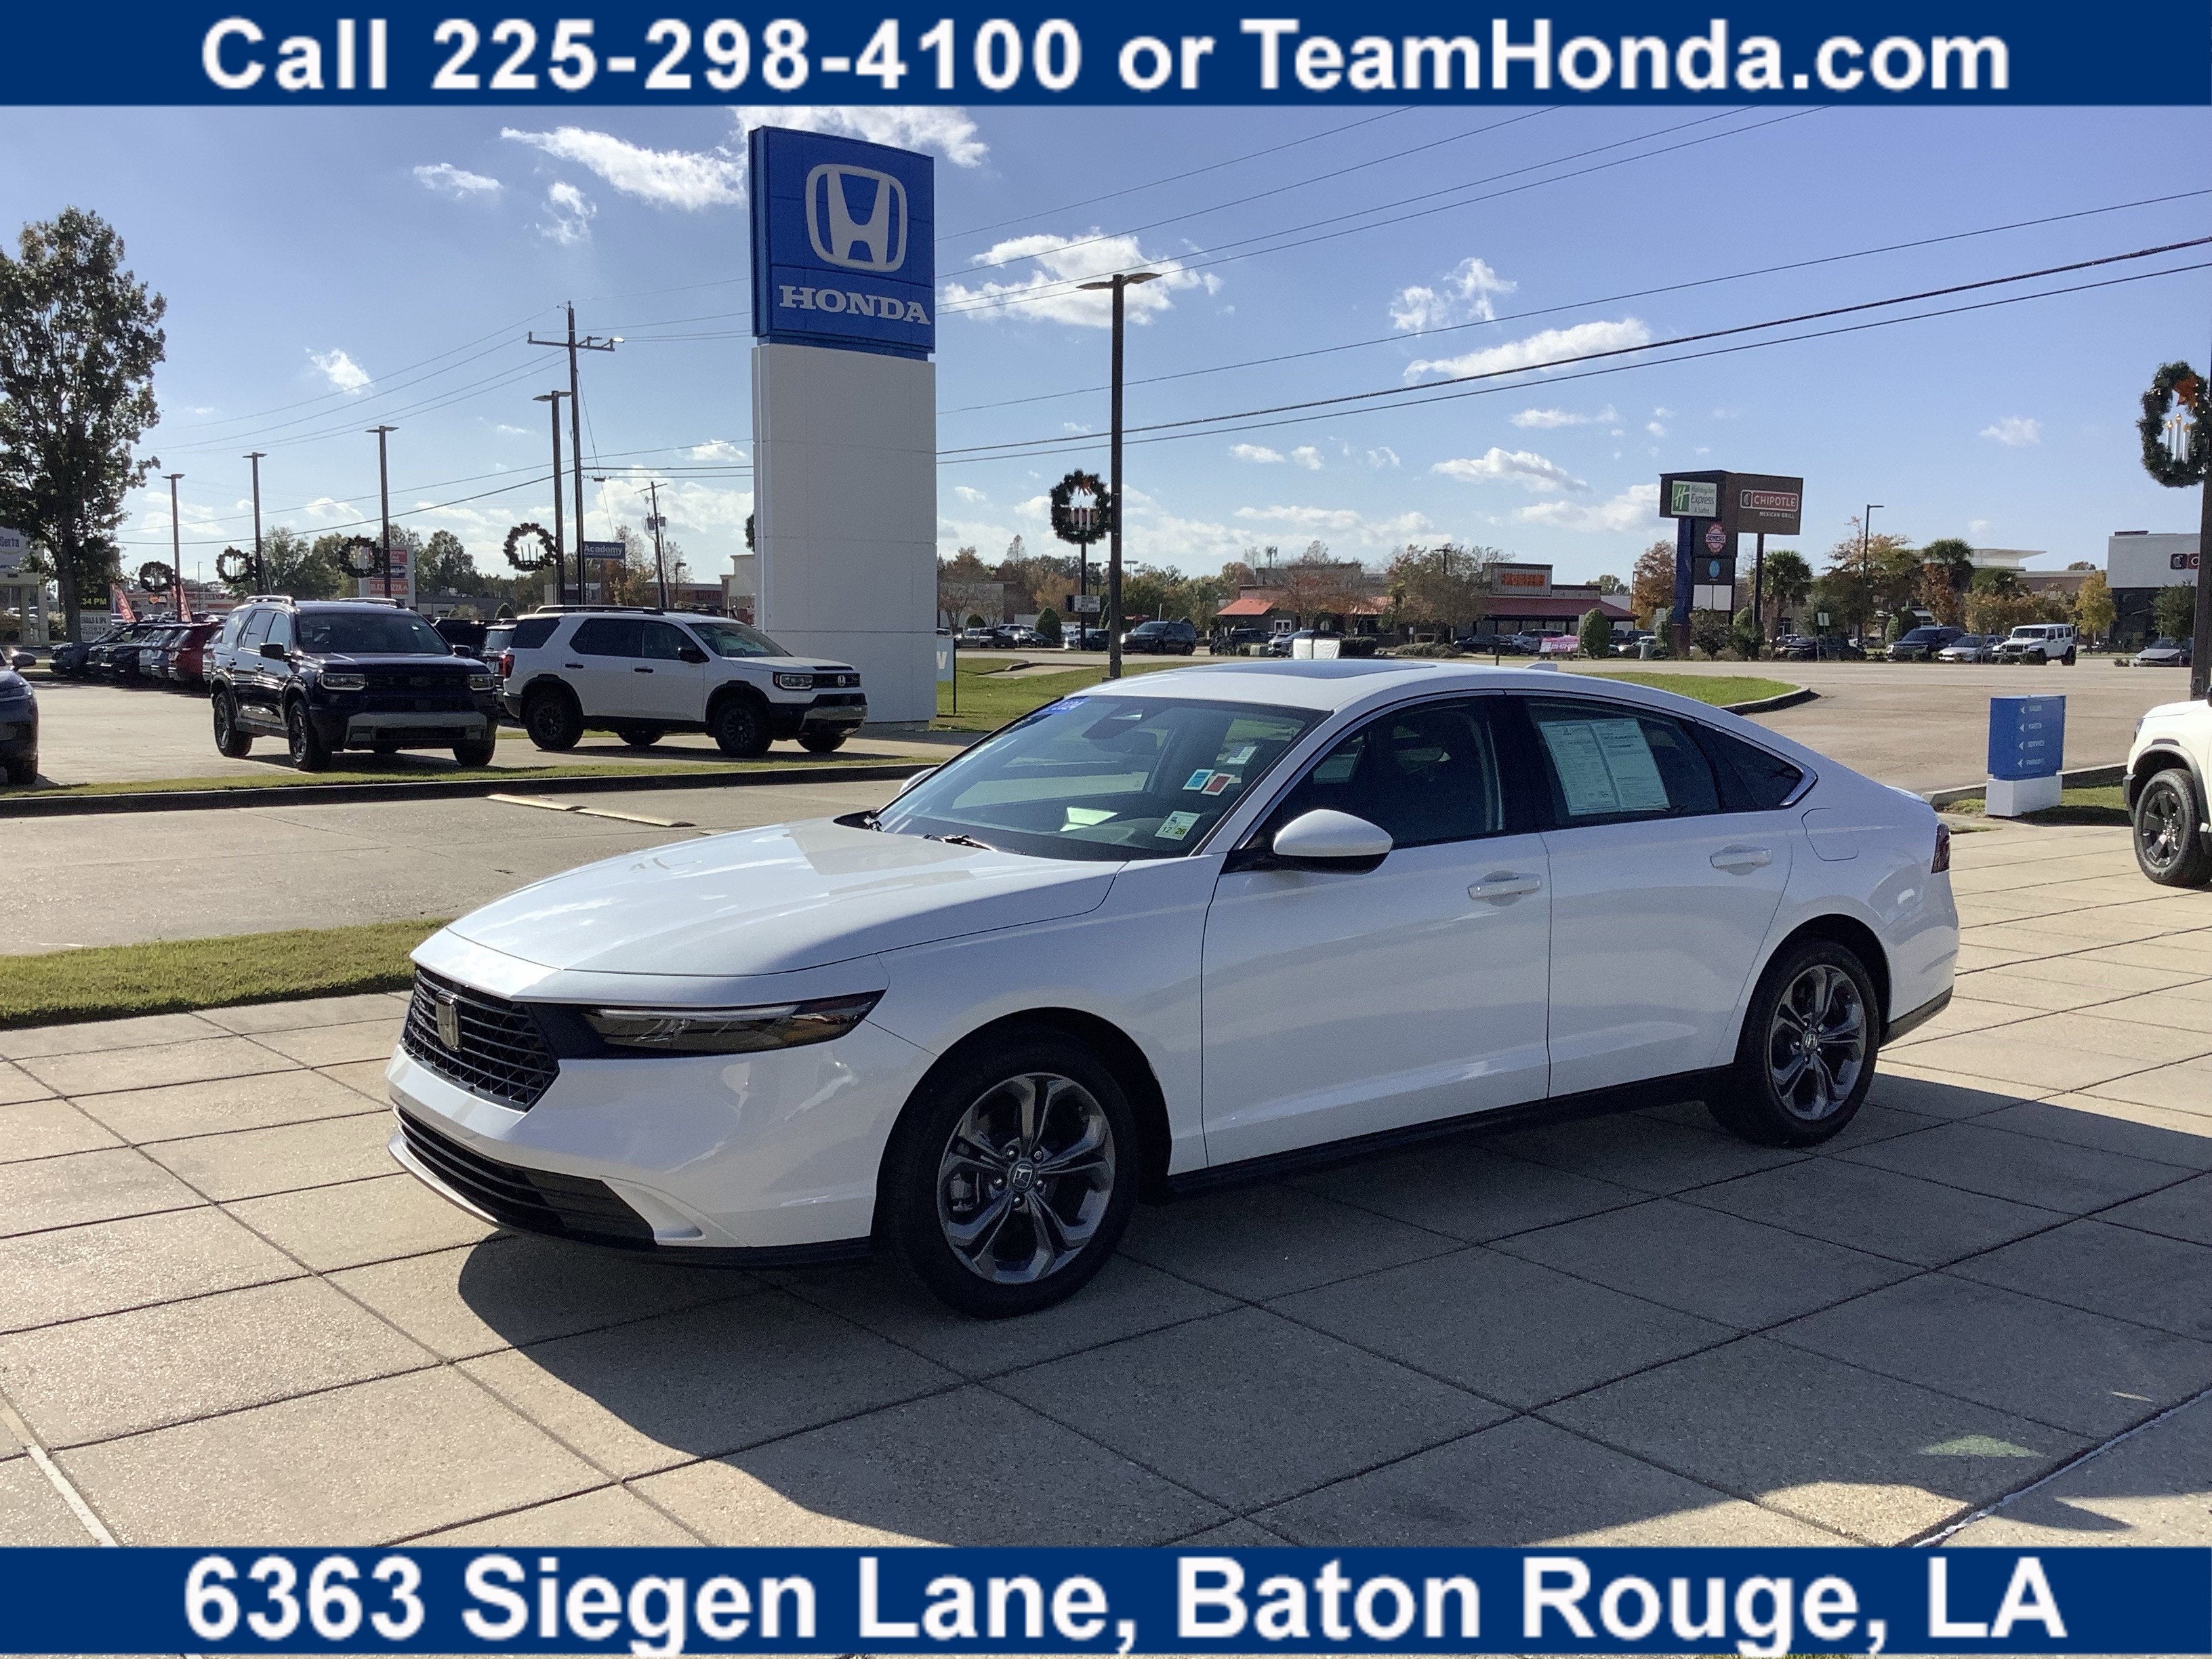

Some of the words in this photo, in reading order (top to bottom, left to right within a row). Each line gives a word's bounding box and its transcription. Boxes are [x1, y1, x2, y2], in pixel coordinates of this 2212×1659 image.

[779, 285, 931, 326] HONDA
[1691, 493, 1715, 506] Express
[1754, 495, 1797, 507] CHIPOTLE
[584, 545, 623, 556] Academy
